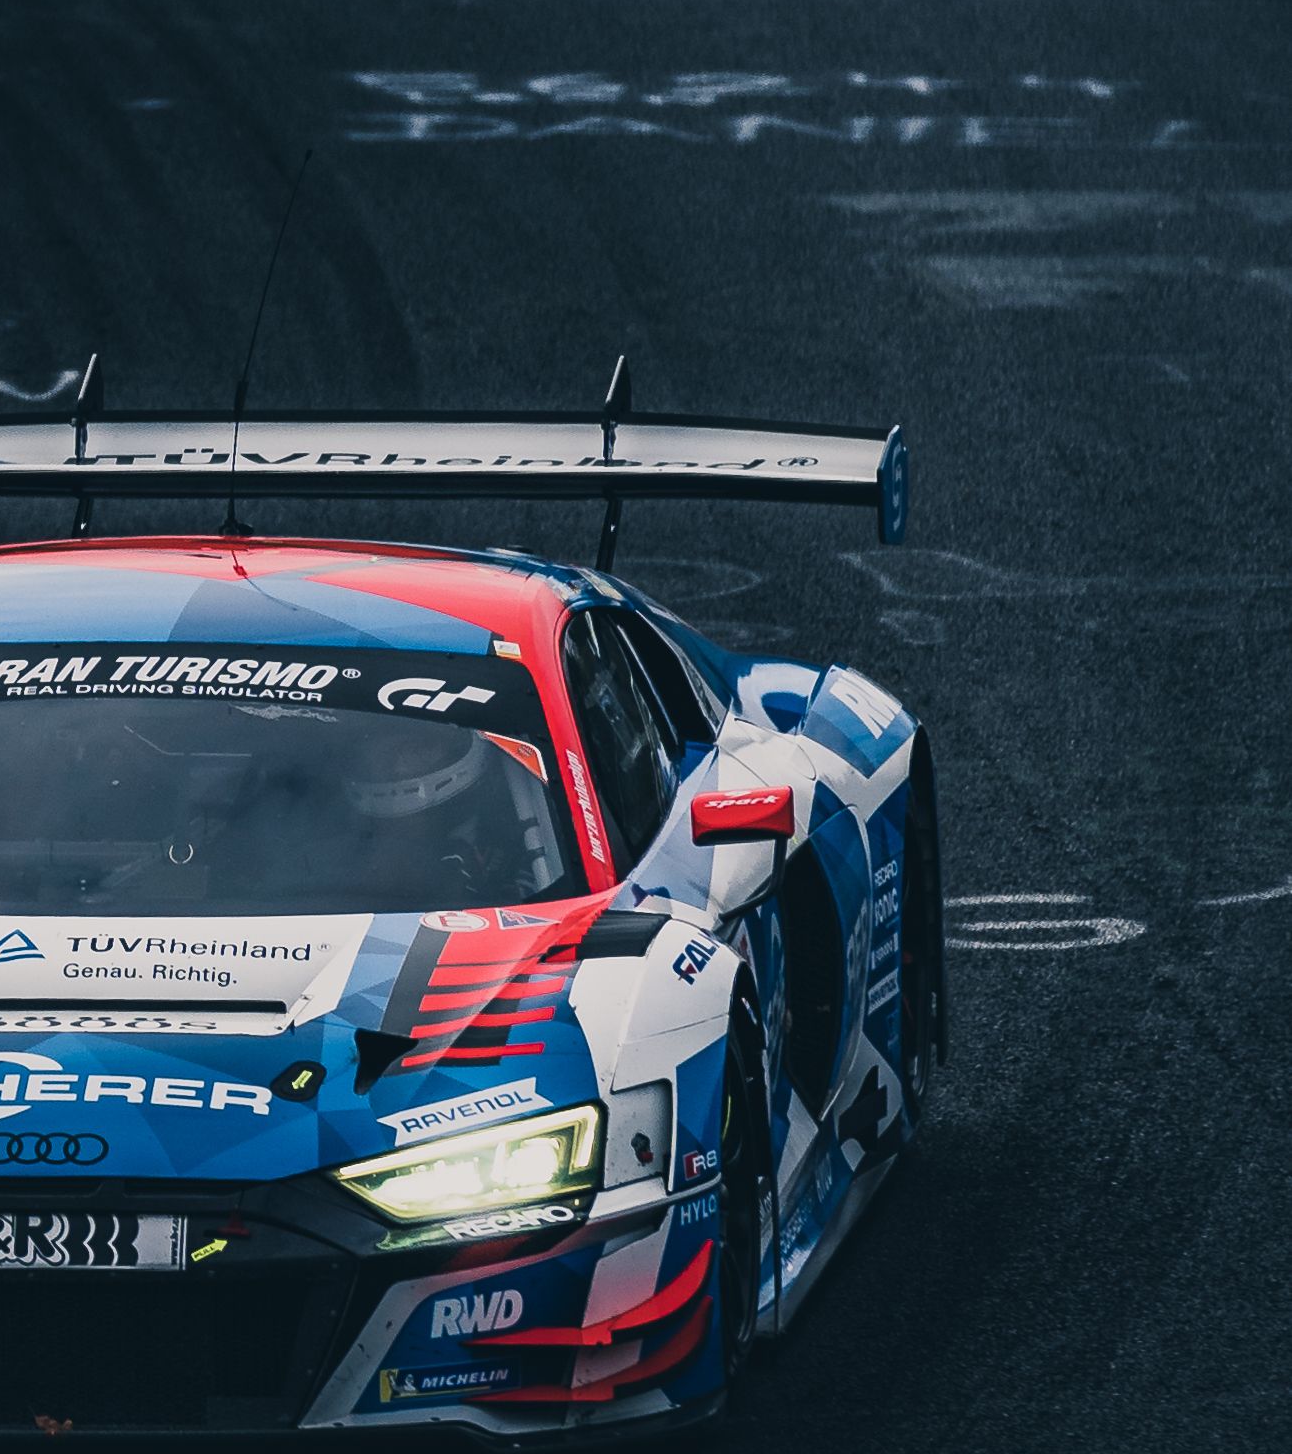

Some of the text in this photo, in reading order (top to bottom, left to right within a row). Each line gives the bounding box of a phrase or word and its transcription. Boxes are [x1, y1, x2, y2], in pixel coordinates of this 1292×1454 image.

[111, 656, 339, 690] TURISMO
[4, 685, 71, 698] REAL
[76, 683, 173, 695] DRIVING
[181, 684, 323, 702] SIMULATOR
[704, 794, 780, 810] spark
[68, 933, 312, 962] TÜVRheinland
[63, 962, 238, 987] Genau. Richtig.
[400, 1090, 534, 1134] RAVENOL
[443, 1204, 575, 1242] RECARO
[430, 1289, 524, 1339] RWD
[421, 1368, 510, 1389] MICHELIN
